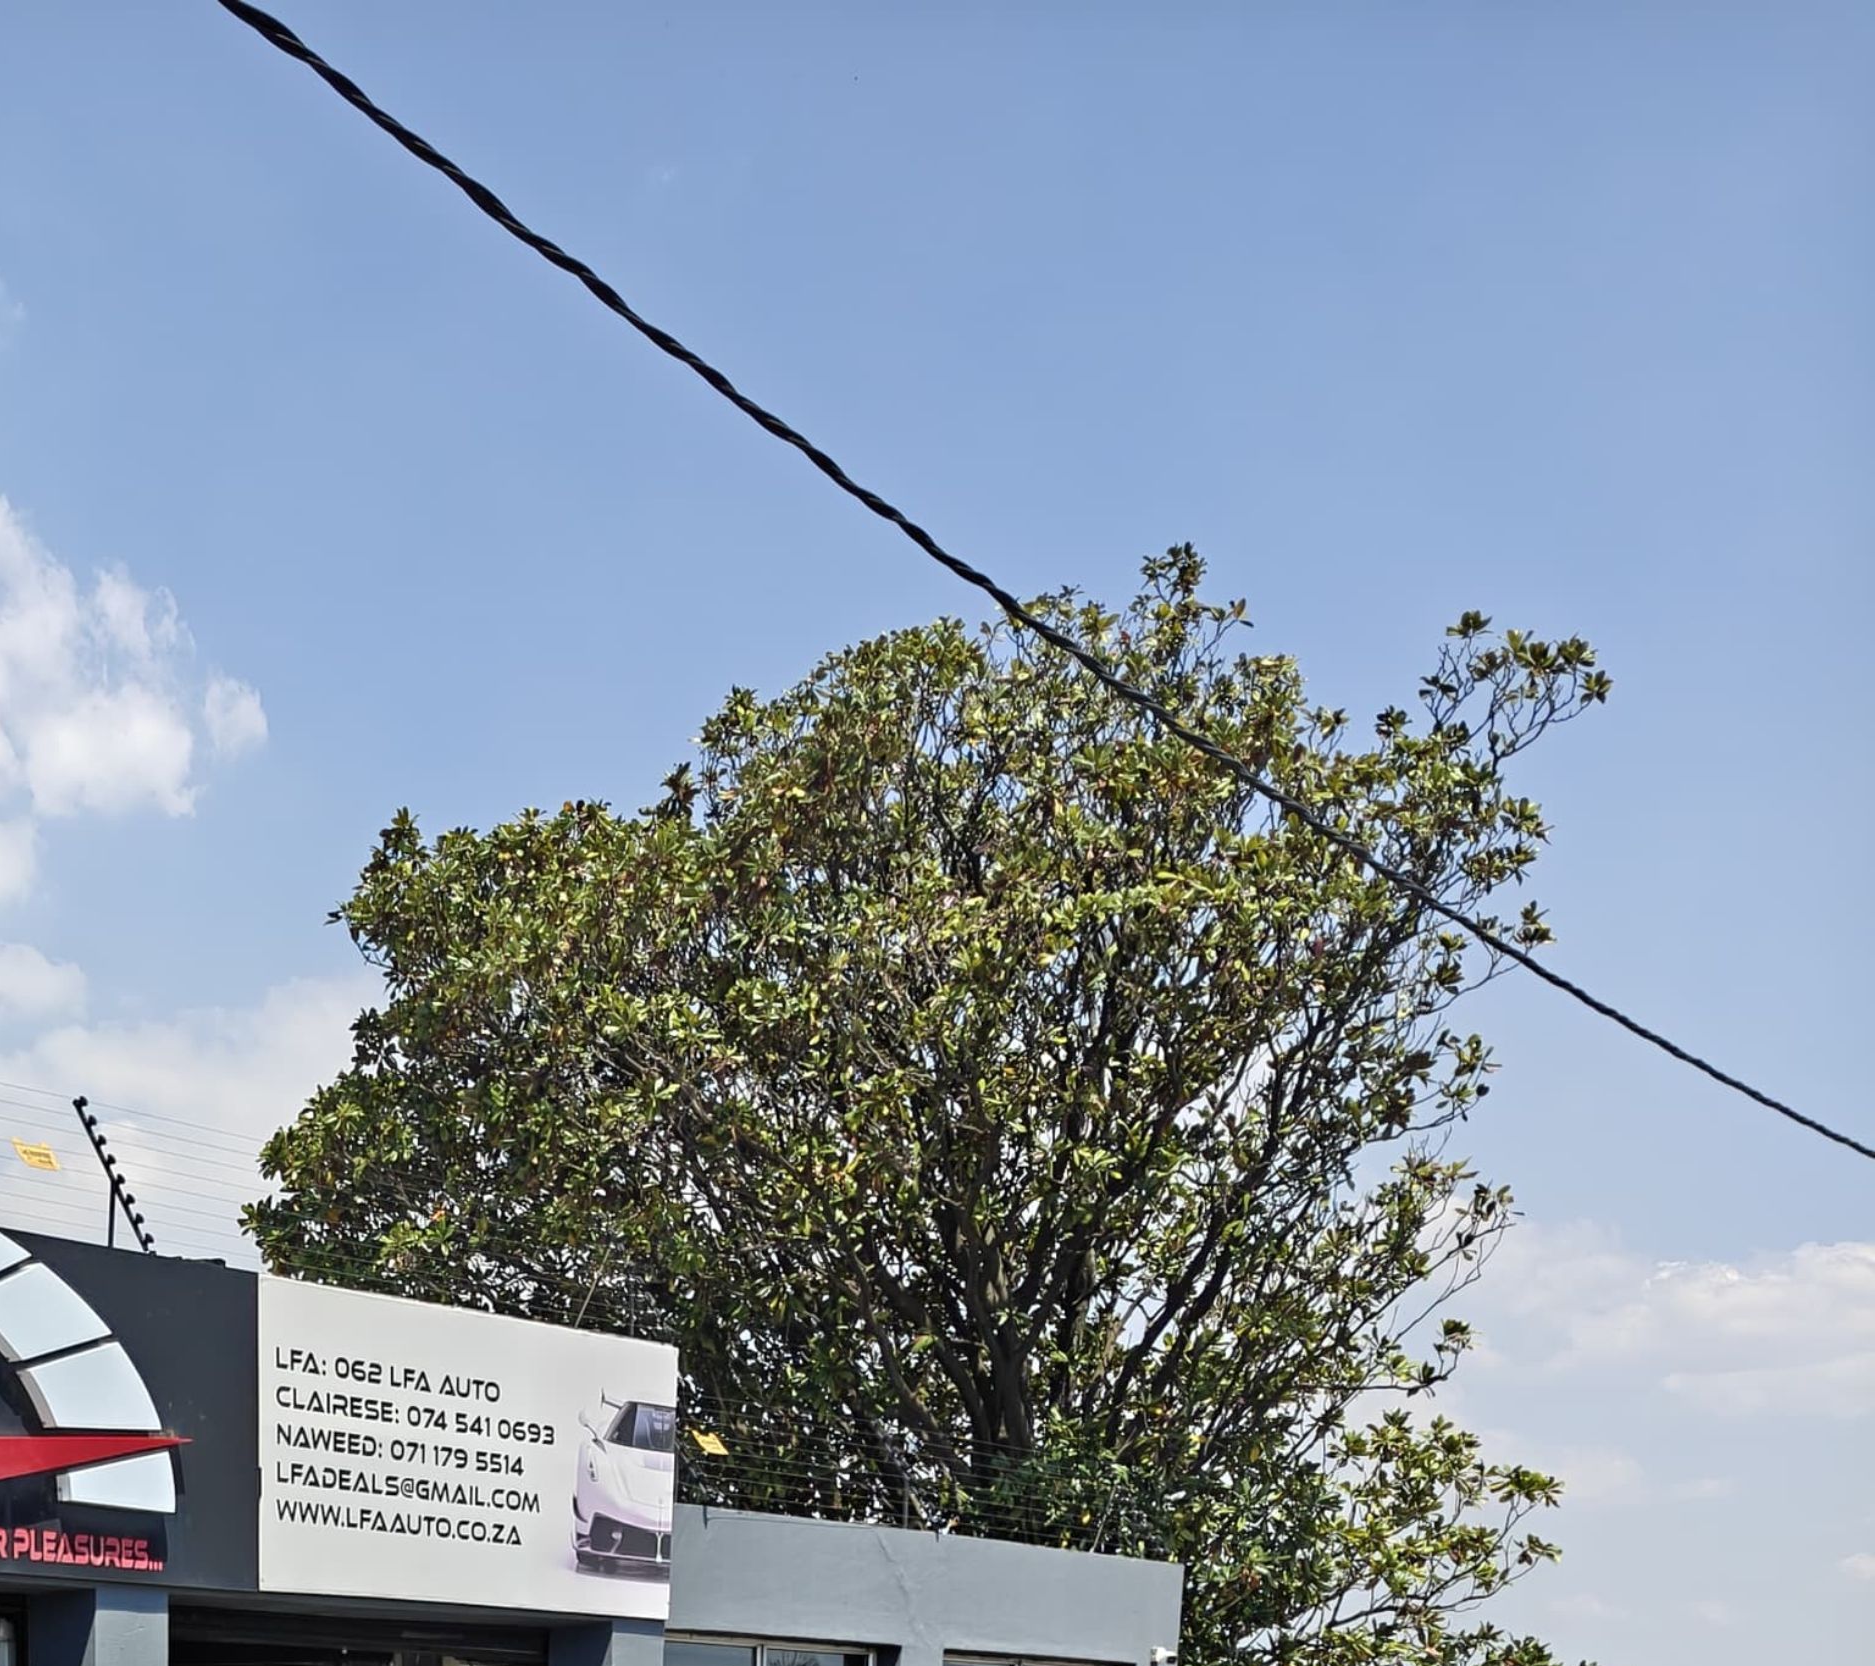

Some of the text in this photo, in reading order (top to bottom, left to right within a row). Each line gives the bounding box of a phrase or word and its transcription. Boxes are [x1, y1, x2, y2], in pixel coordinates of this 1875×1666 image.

[276, 1347, 500, 1403] LFA: 062 LFA AUTO
[276, 1386, 555, 1445] CLAIRESE: 074 541 0693
[277, 1423, 524, 1476] NAWEED: 071 179 5514
[277, 1461, 540, 1513] LFADEALS@GMAIL.COM
[276, 1499, 522, 1546] WWW.LFAAUTO.CO.ZA
[12, 1527, 165, 1572] PLEASURES...
